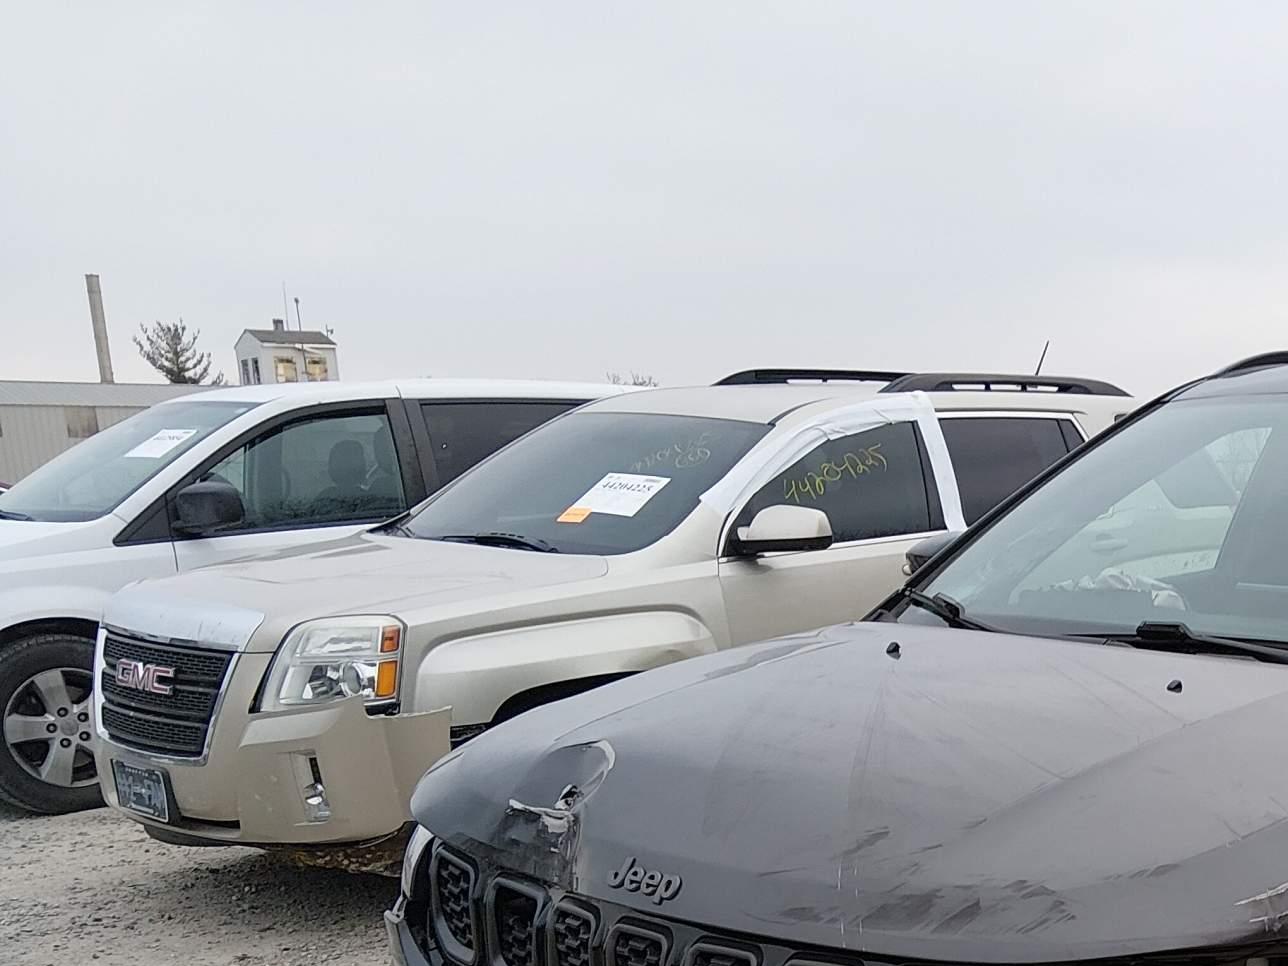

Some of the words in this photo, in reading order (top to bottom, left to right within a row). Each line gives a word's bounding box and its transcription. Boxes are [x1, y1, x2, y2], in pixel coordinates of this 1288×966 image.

[783, 442, 887, 503] 44204225
[116, 659, 175, 695] GMC
[608, 856, 682, 905] Jeep
